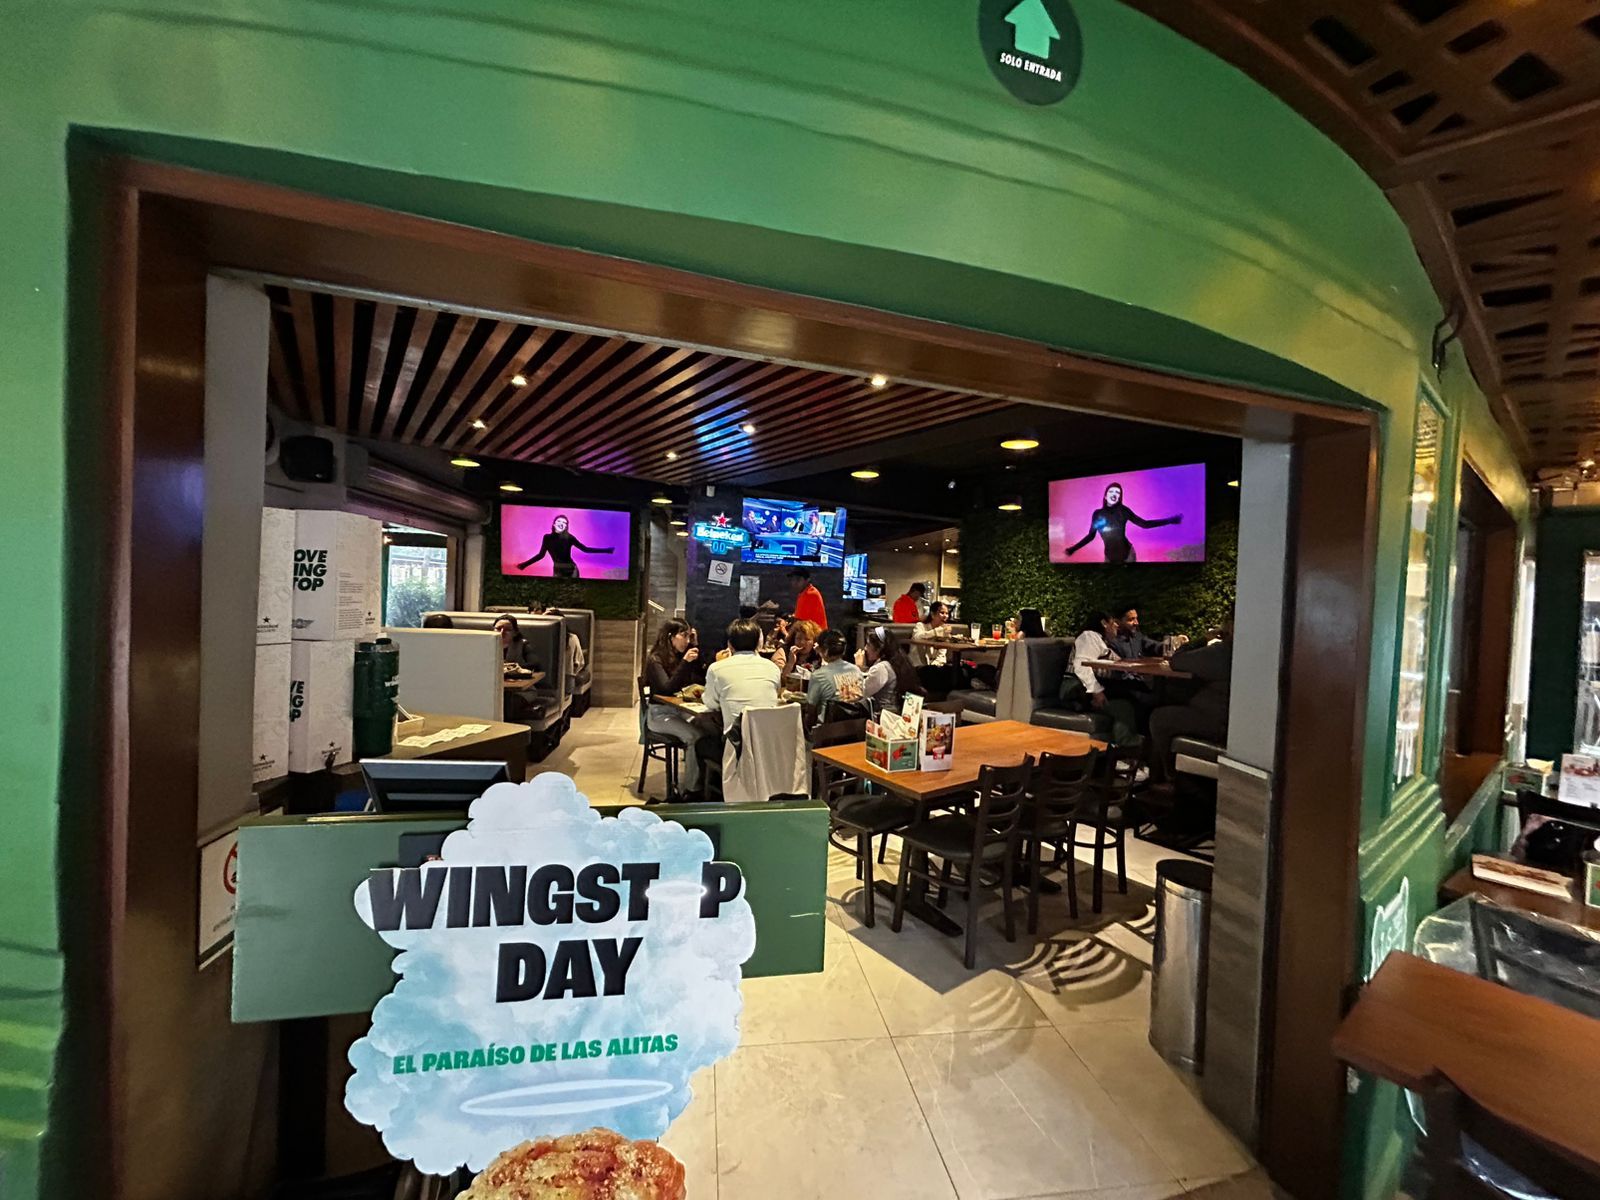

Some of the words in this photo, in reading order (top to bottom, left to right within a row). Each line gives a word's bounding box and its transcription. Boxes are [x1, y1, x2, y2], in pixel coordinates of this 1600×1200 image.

[999, 52, 1022, 68] SOLO
[1024, 60, 1062, 82] ENTRADA
[293, 563, 327, 577] ING
[294, 549, 328, 563] OVE
[495, 937, 644, 1003] DAY
[392, 1055, 417, 1075] EL
[421, 1043, 525, 1072] PARAÍSO
[529, 1043, 557, 1063] DE
[563, 1039, 603, 1061] LAS
[606, 1033, 679, 1057] ALITAS
